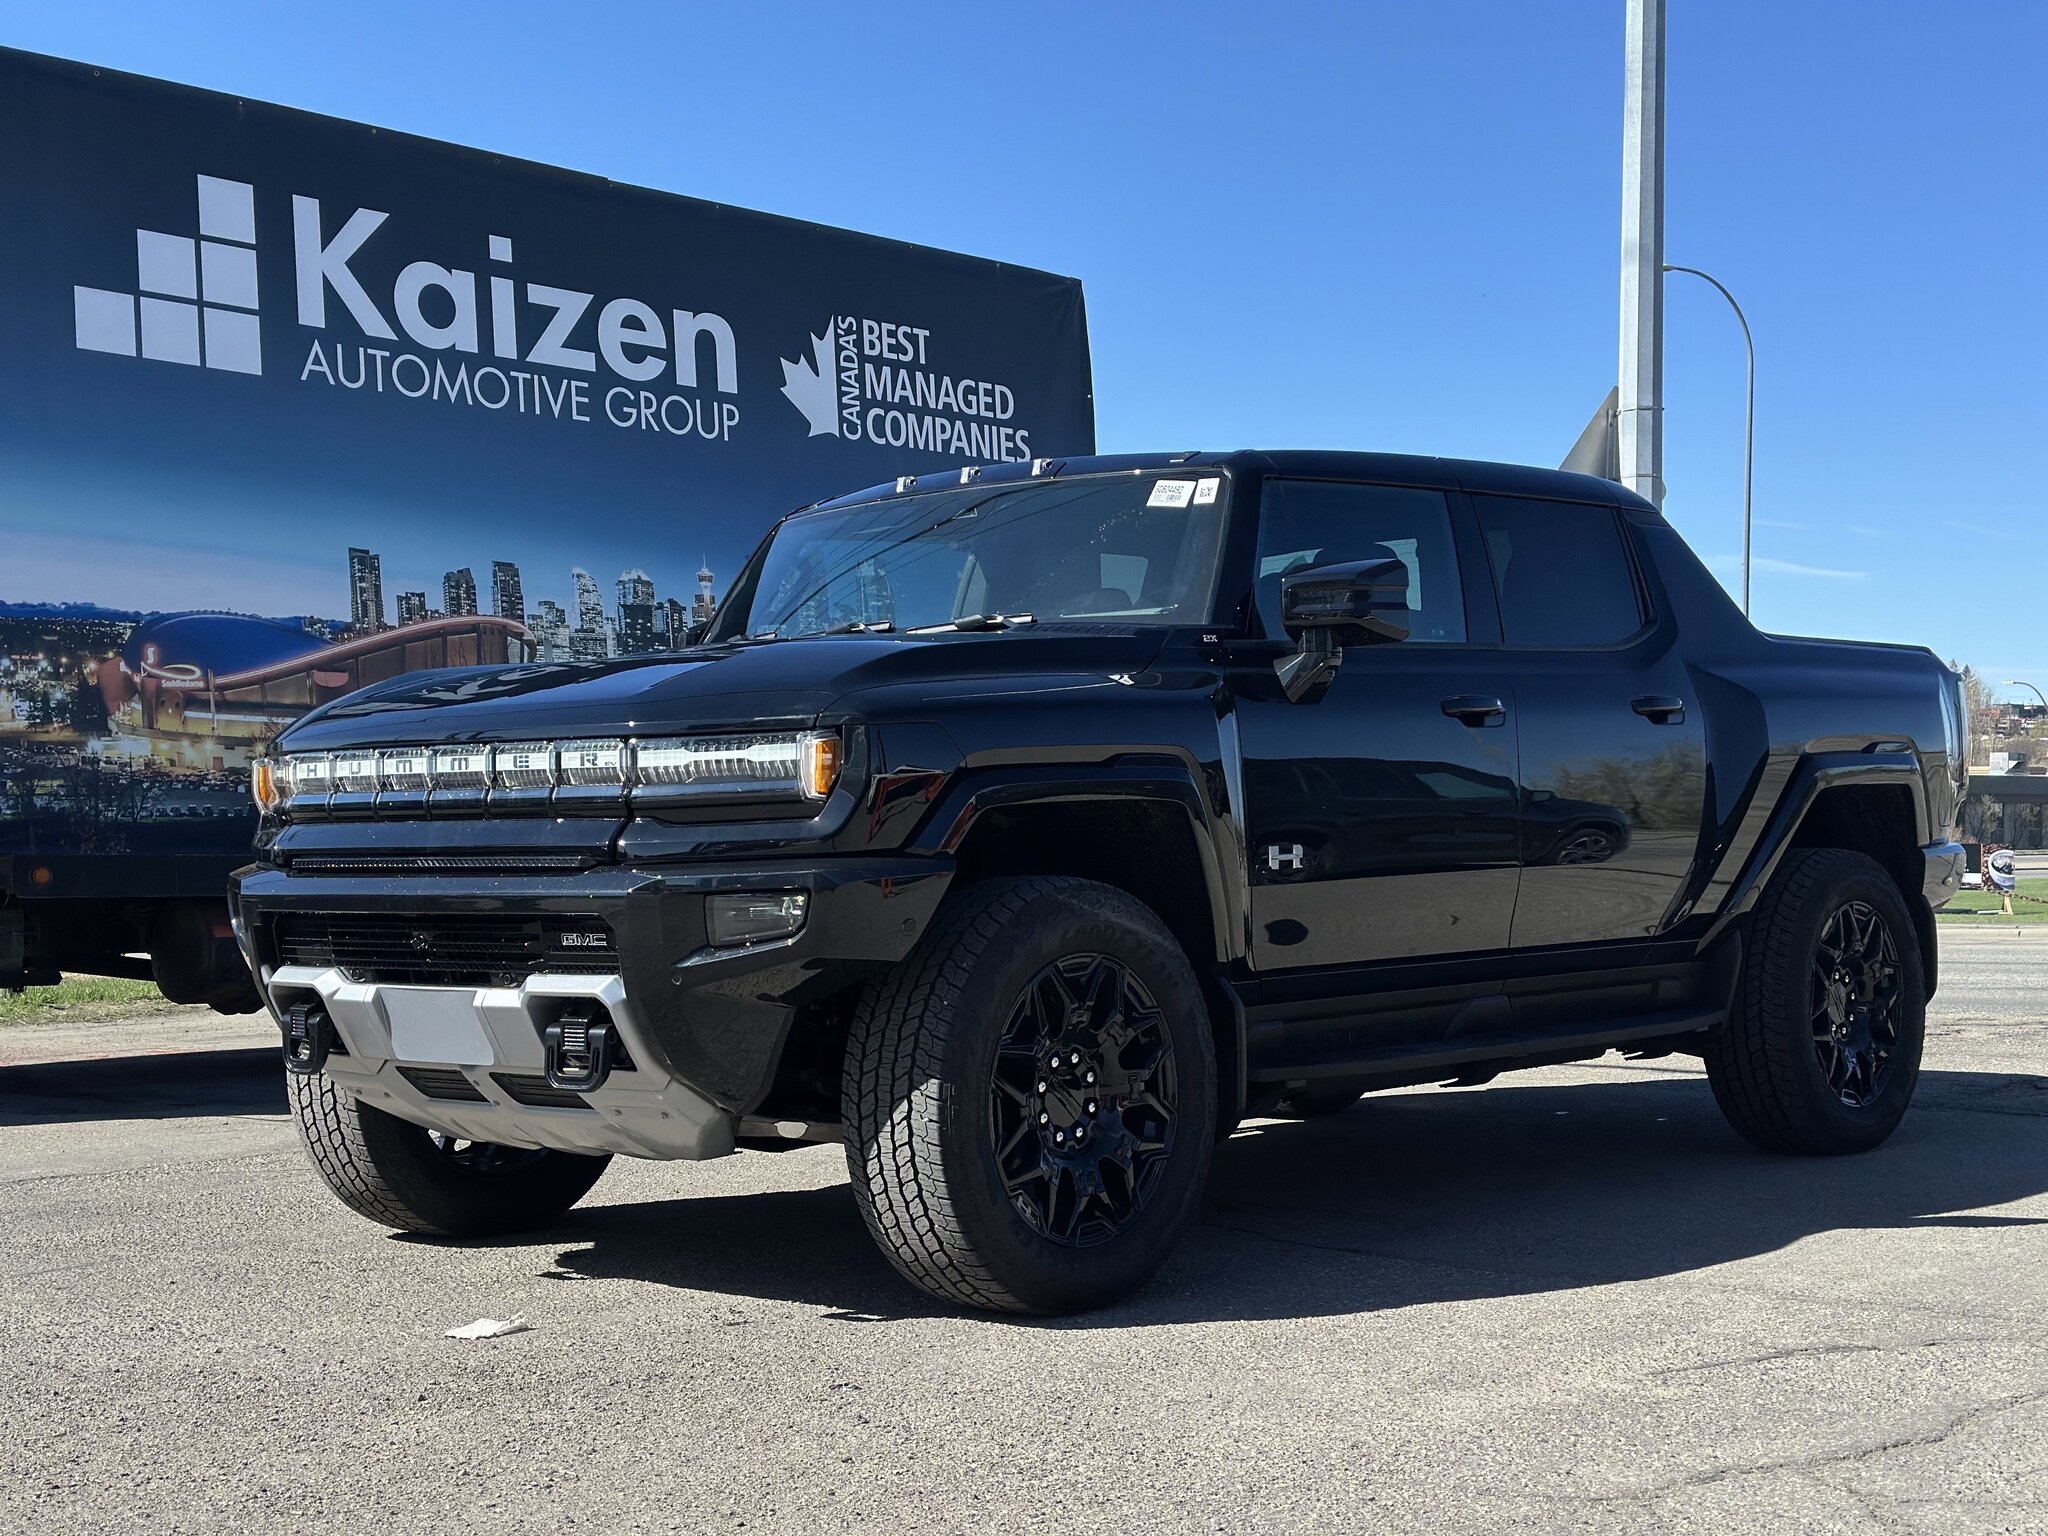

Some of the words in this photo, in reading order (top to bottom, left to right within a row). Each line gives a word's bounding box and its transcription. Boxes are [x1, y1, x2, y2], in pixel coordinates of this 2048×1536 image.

[292, 194, 739, 394] Kaizen
[862, 318, 930, 365] BEST
[301, 338, 591, 423] AUTOMOTIVE
[604, 386, 741, 442] GROUP
[837, 315, 862, 441] CANADA'S
[864, 362, 1015, 420] MANAGED
[866, 407, 1032, 463] COMPANIES
[1202, 634, 1218, 643] 2X
[306, 752, 598, 777] HUMMER
[560, 932, 608, 946] GMC
